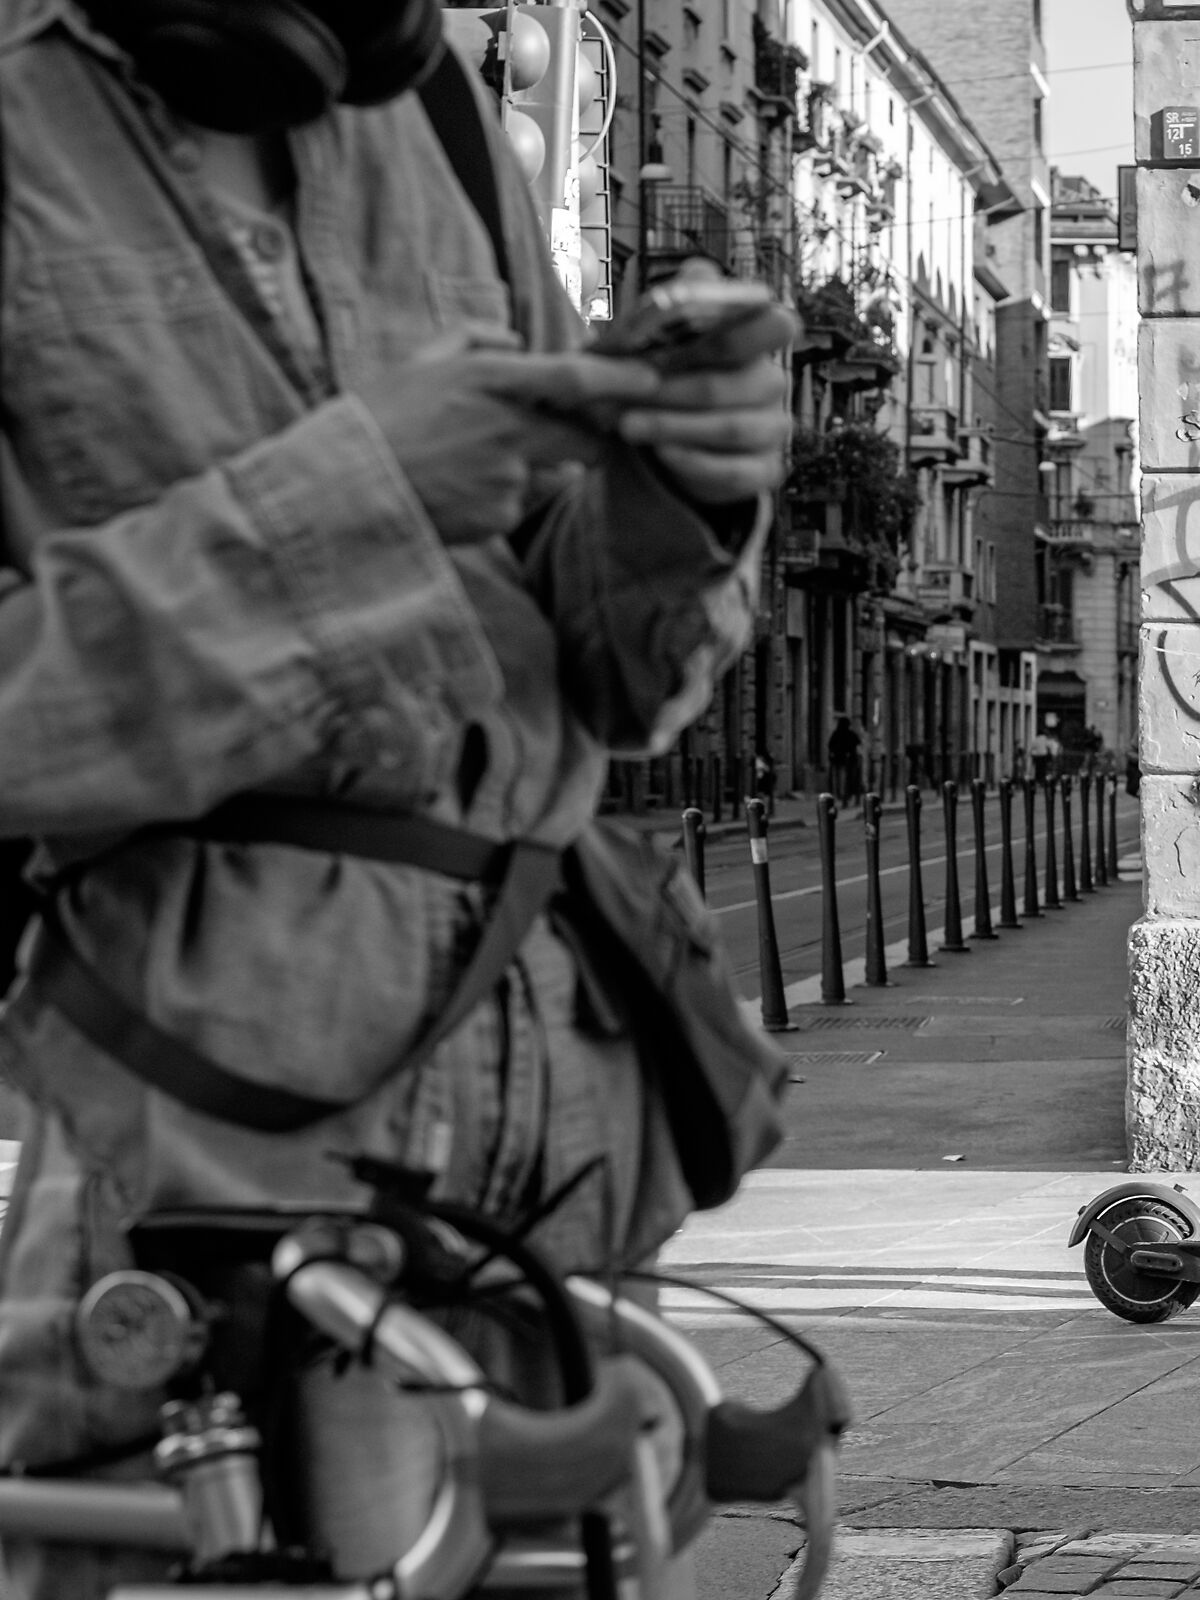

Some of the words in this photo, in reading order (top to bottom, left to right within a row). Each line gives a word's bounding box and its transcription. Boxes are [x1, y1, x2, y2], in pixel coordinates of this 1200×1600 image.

[1166, 112, 1179, 123] SR
[1167, 128, 1180, 140] 12
[1179, 143, 1192, 155] 15
